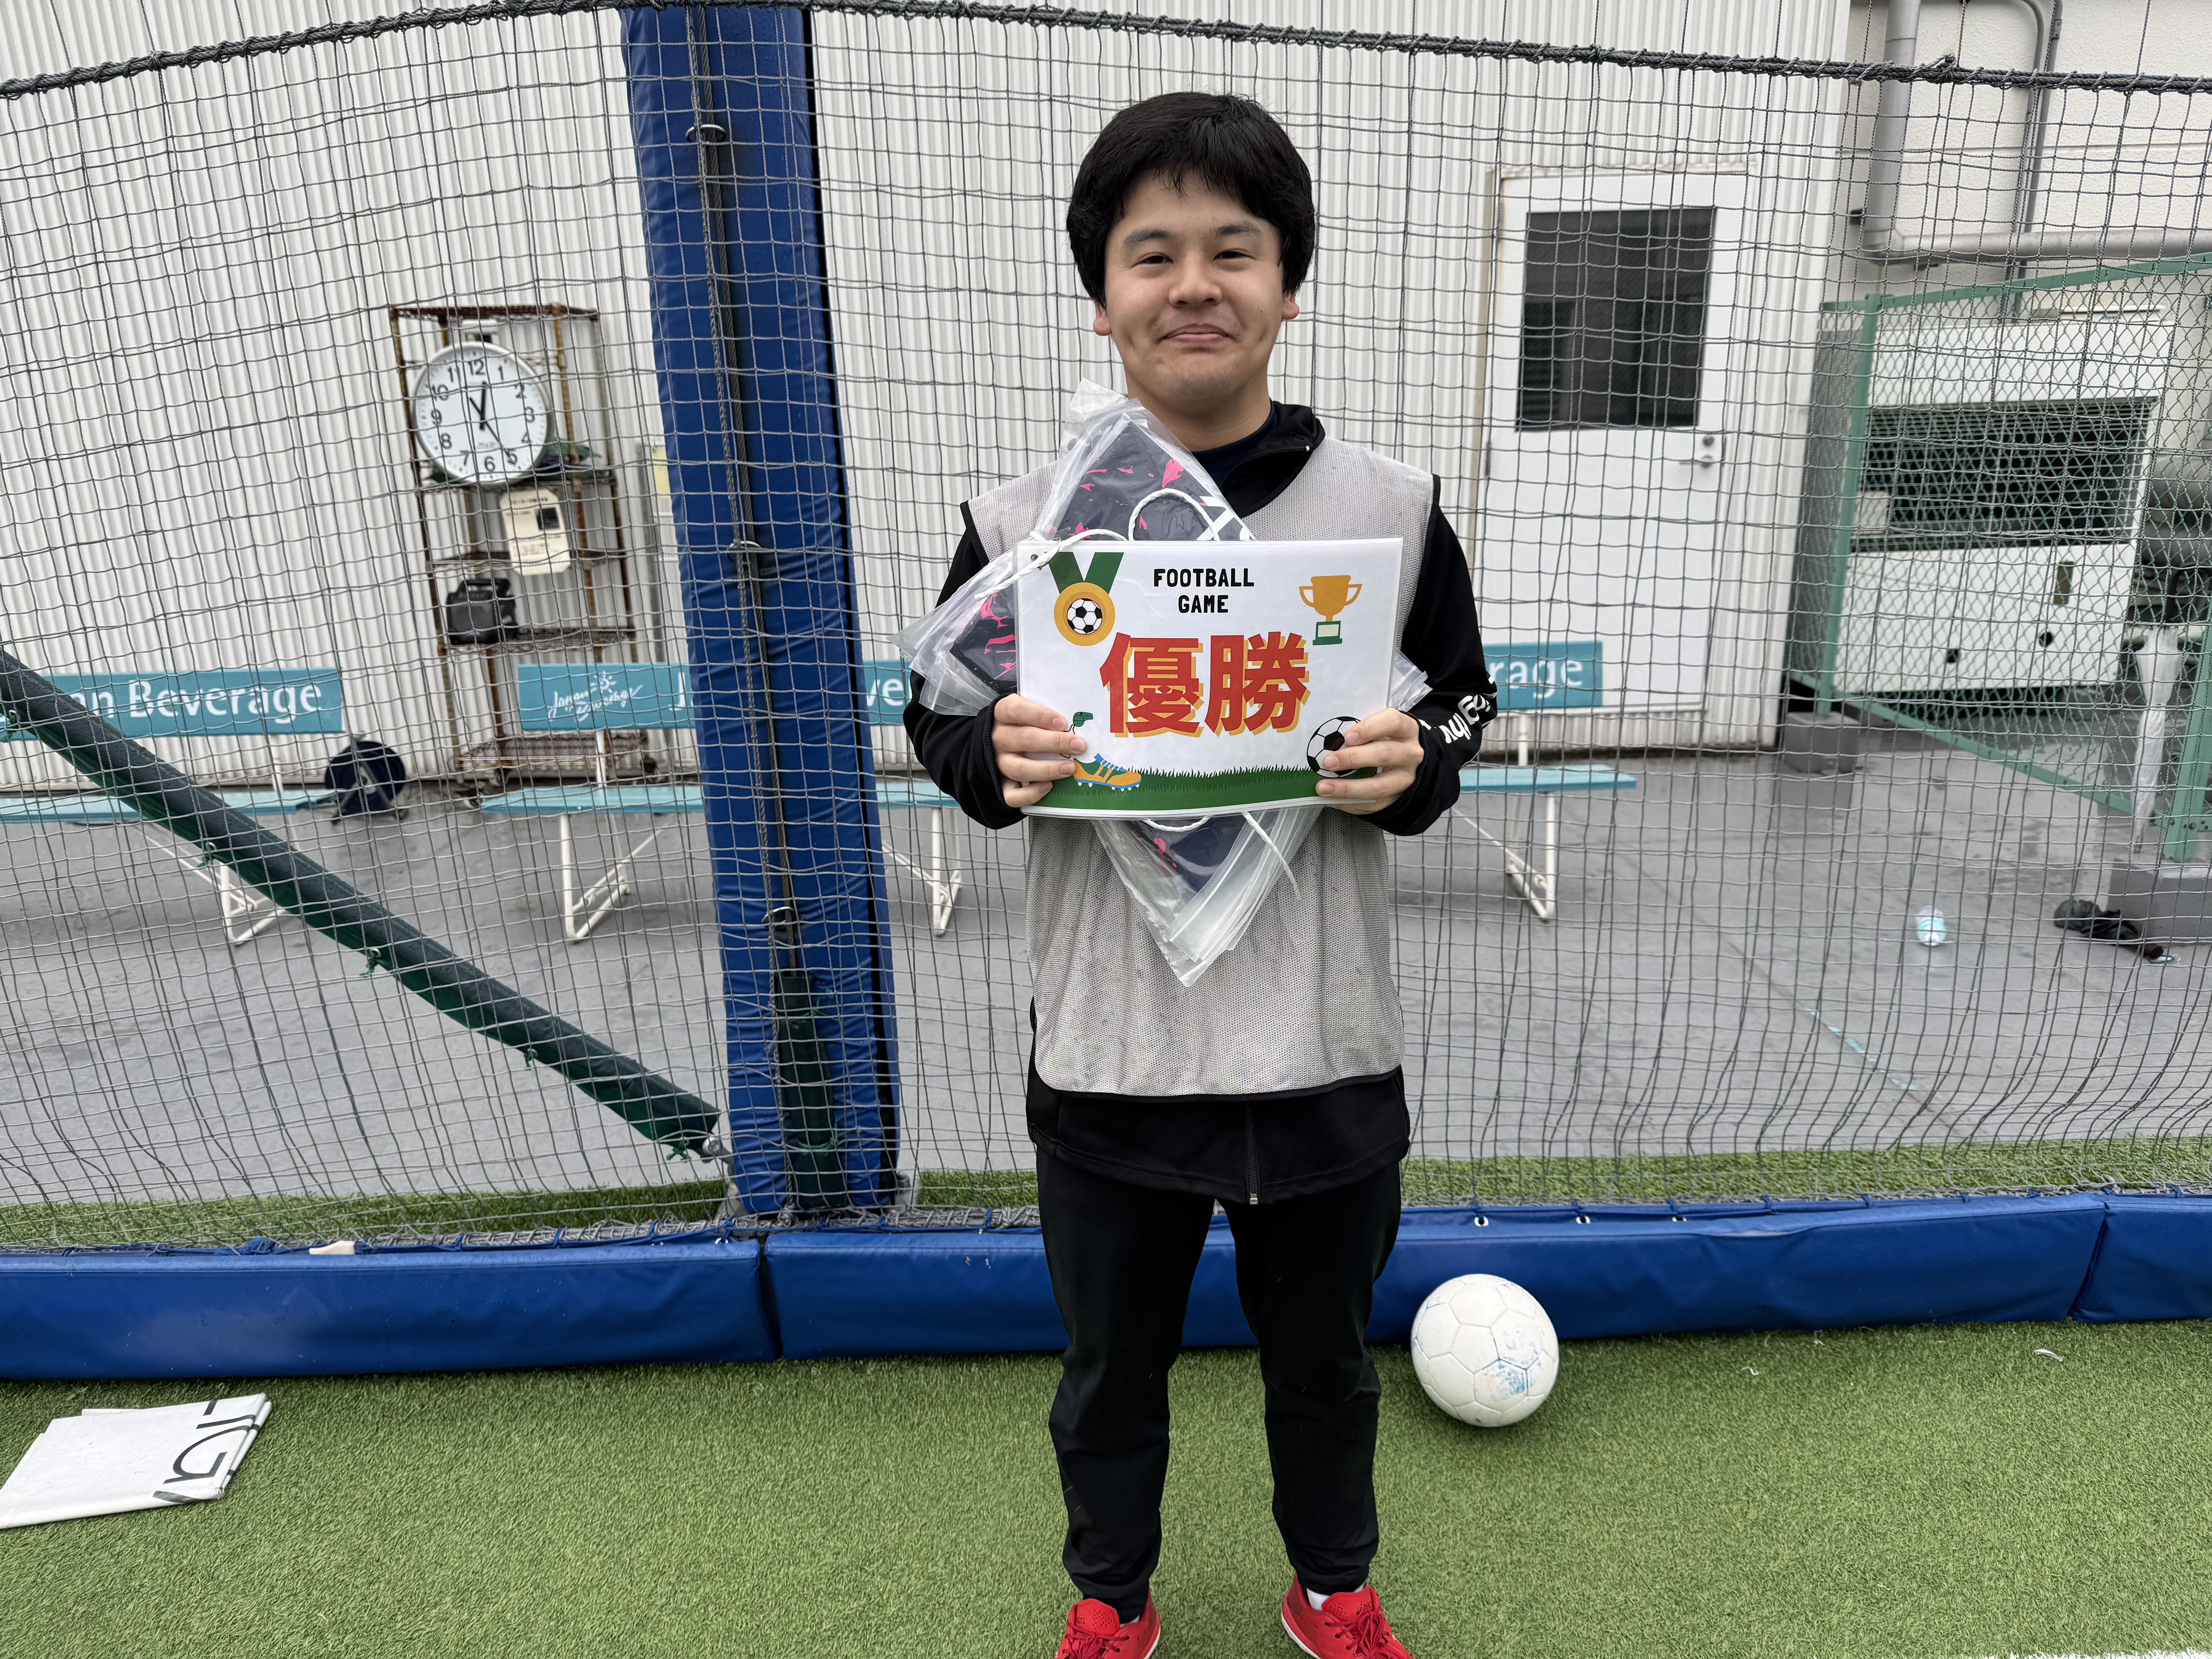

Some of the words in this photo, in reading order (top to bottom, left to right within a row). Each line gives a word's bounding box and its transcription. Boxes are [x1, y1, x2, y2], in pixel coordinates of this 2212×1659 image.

[468, 359, 486, 375] 12
[498, 366, 504, 380] 1
[431, 385, 449, 401] 10
[514, 383, 527, 399] 2
[431, 409, 442, 425] 9
[525, 407, 535, 422] 3
[441, 433, 452, 449] 8
[522, 432, 532, 445] 4
[460, 450, 471, 465] 7
[484, 456, 496, 472] 6
[507, 449, 518, 465] 5
[1154, 568, 1254, 587] FOOTBALL
[1178, 595, 1228, 613] GAME
[1099, 631, 1311, 738] 優勝
[128, 679, 322, 725] Beverage
